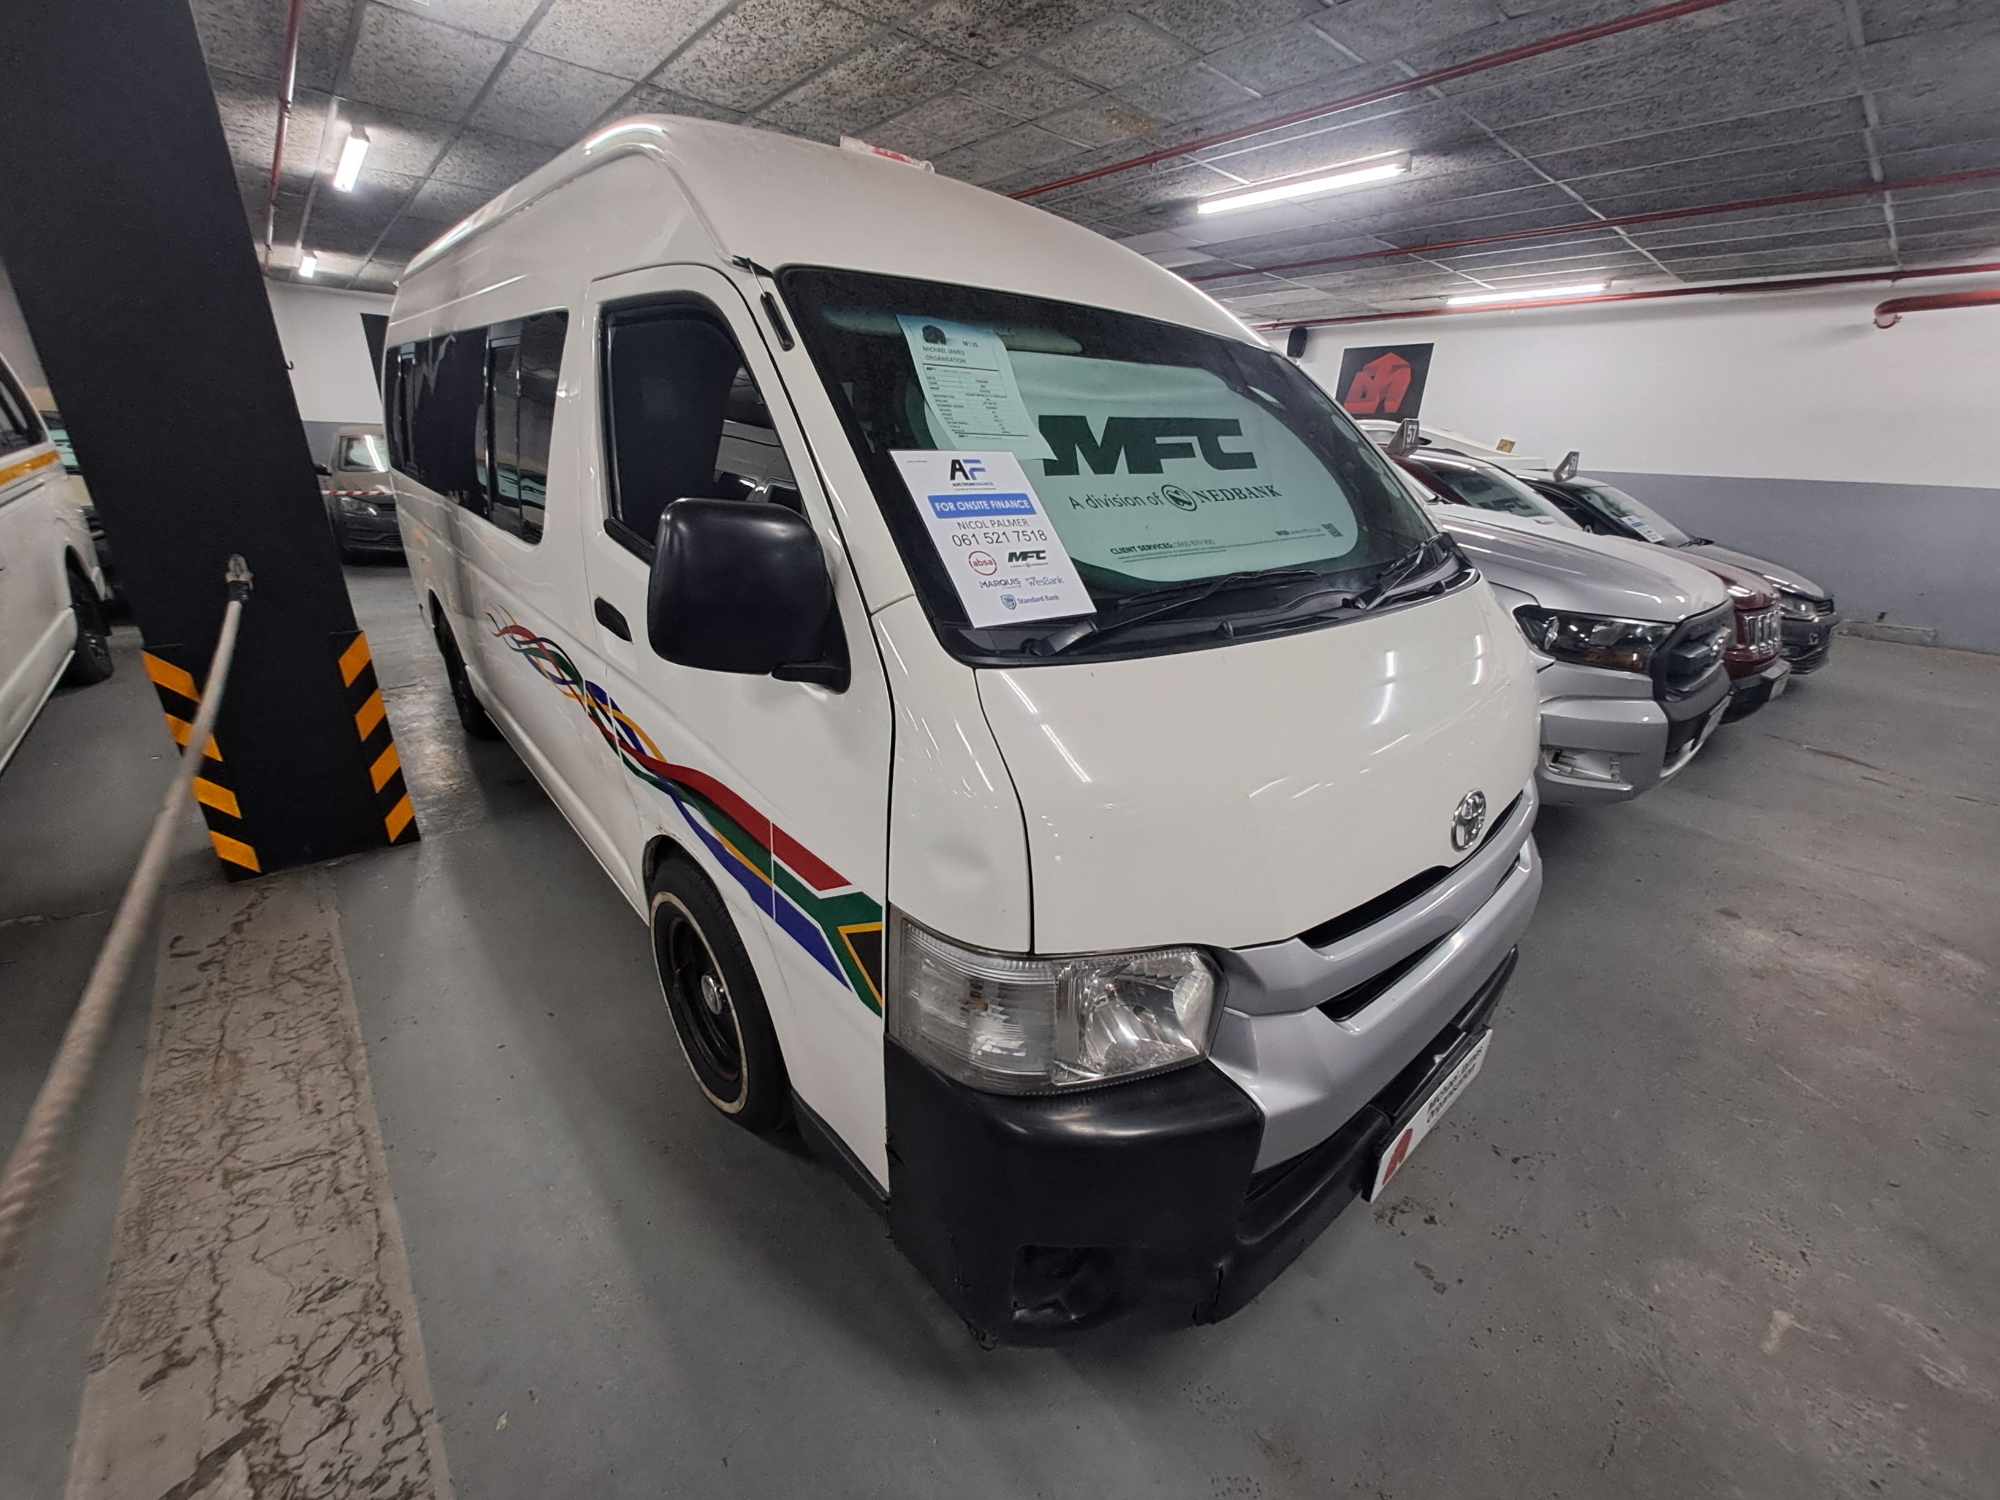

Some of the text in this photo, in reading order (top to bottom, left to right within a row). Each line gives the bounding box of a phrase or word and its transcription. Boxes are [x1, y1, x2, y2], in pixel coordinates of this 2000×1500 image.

[1038, 414, 1258, 477] MFC
[1069, 484, 1283, 510] A division of NEDBANK
[935, 499, 1031, 511] FOR ONSITE FINANCE
[957, 518, 1031, 530] NICOL PALMER
[952, 528, 1048, 547] 061 521 7518
[1110, 545, 1138, 555] CLIENT
[973, 558, 994, 567] absa
[1008, 550, 1047, 563] MFC
